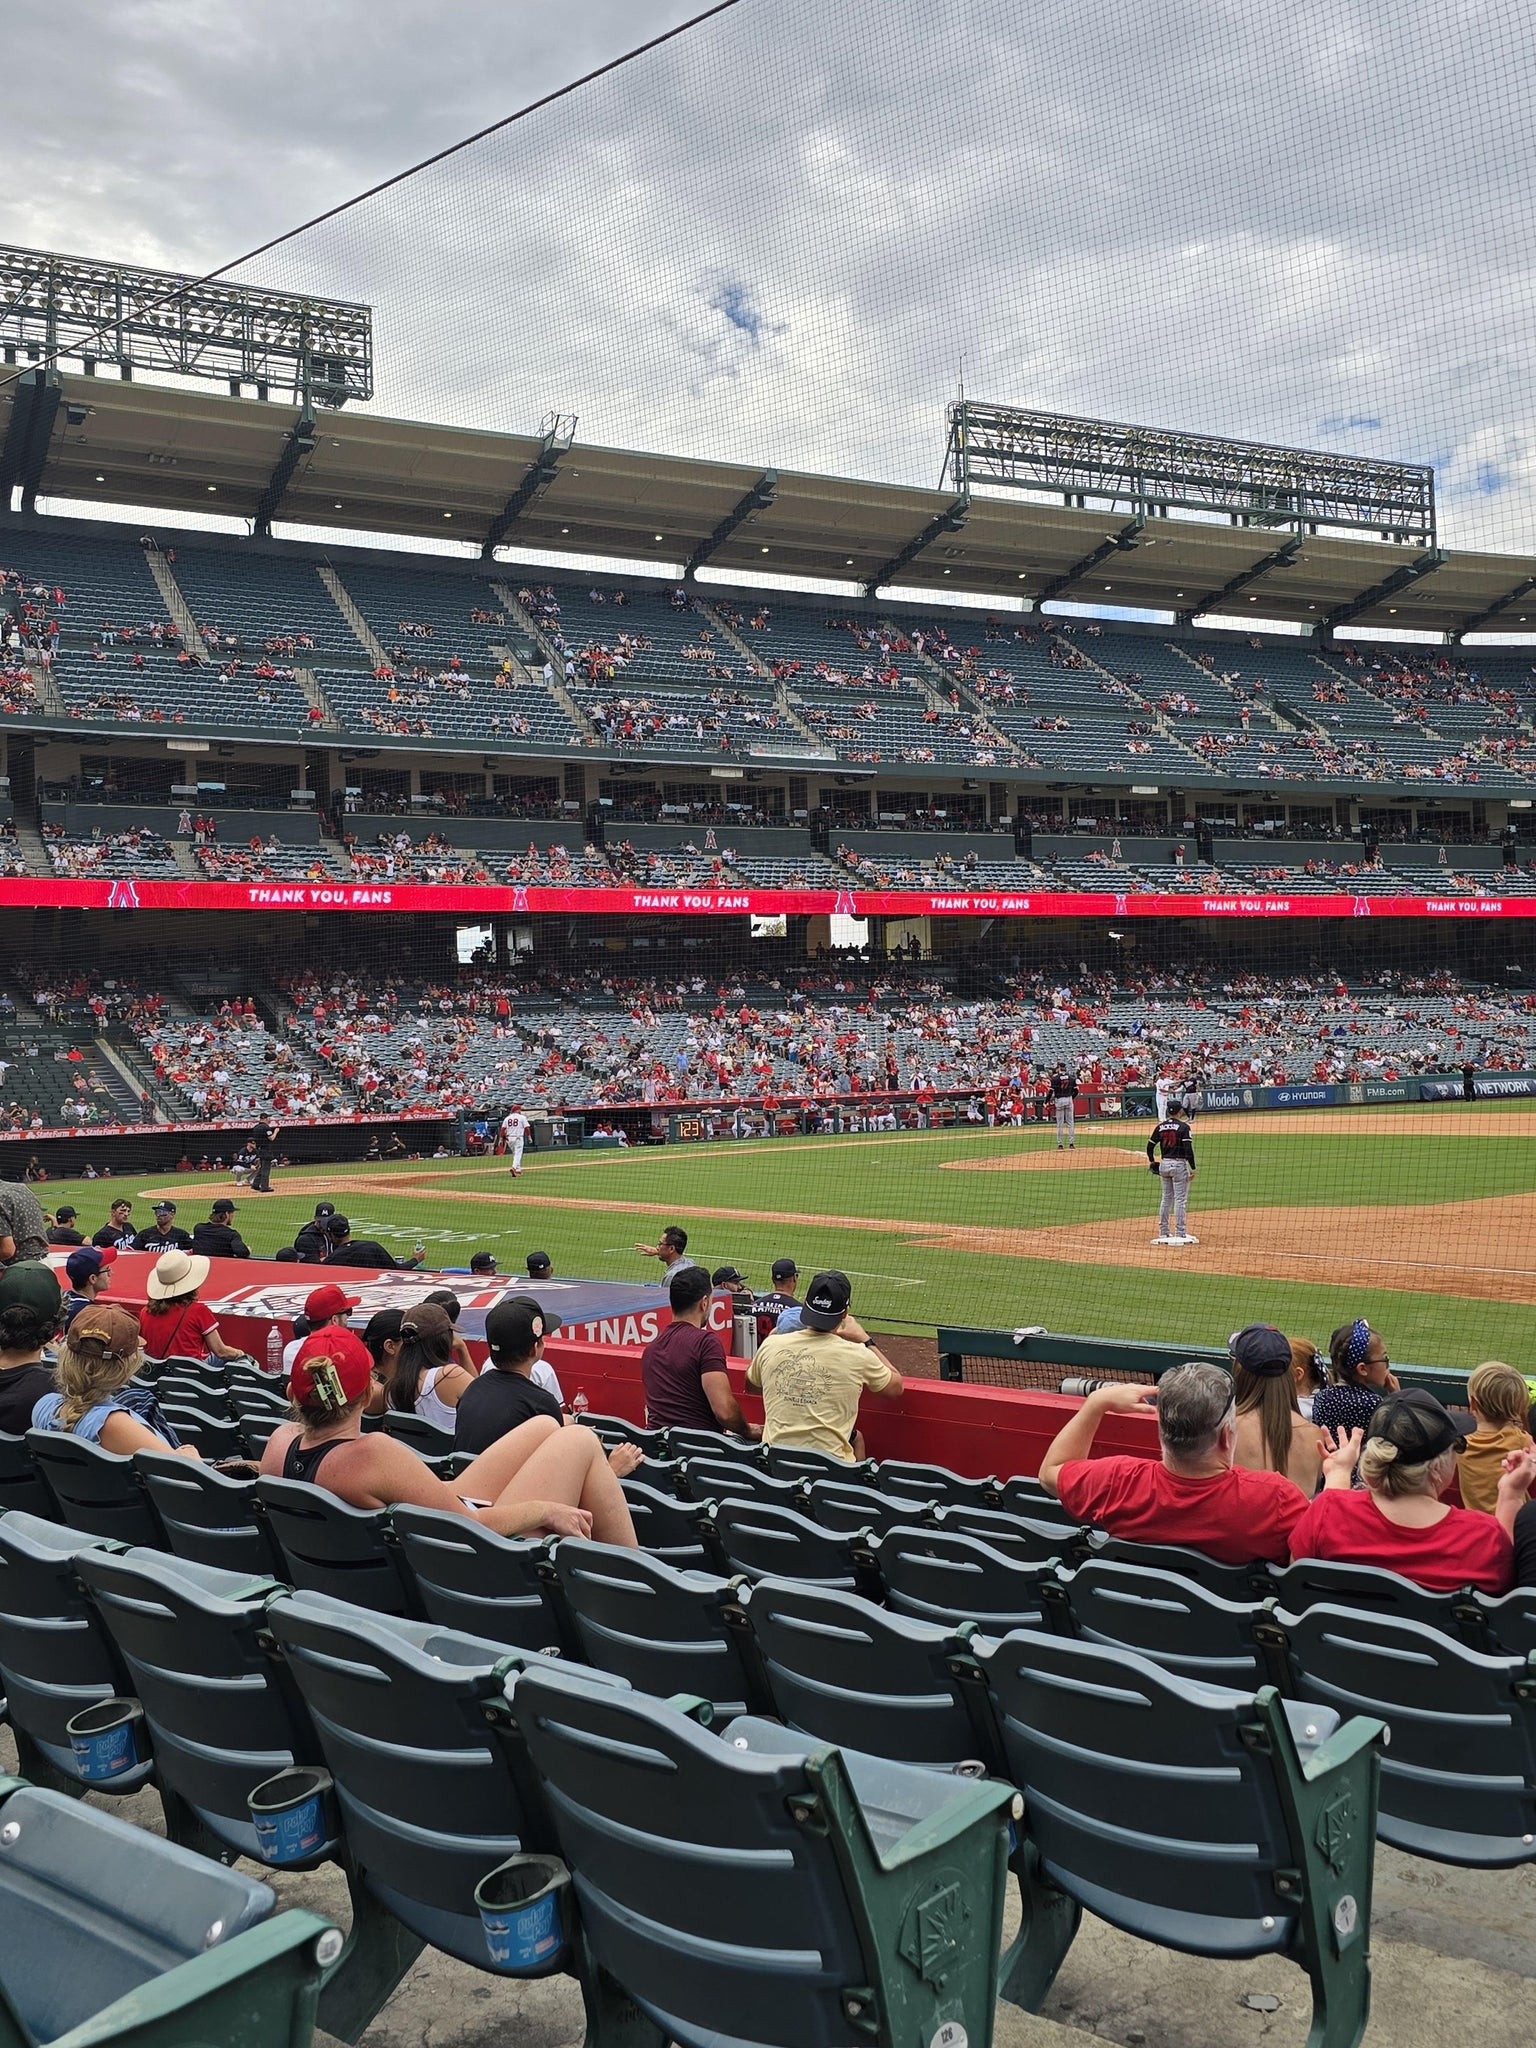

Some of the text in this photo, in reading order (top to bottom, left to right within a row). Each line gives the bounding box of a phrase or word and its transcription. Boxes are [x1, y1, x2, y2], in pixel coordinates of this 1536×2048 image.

[249, 889, 392, 905] THANK YOU, FANS
[633, 895, 749, 909] THANK YOU, FANS
[931, 898, 1030, 911] THANK YOU, FANS
[1203, 901, 1237, 911] THANK
[1265, 901, 1290, 911] FANS
[1426, 902, 1456, 911] THANK
[1480, 902, 1503, 912] FANS
[1366, 1087, 1405, 1097] FMB.com
[1479, 1081, 1531, 1095] NETWORK
[1207, 1092, 1240, 1107] Modelo
[1291, 1091, 1326, 1102] HYUNDAI
[507, 1118, 519, 1127] 88
[550, 1312, 660, 1346] LINAS
[941, 2026, 954, 2045] 126
